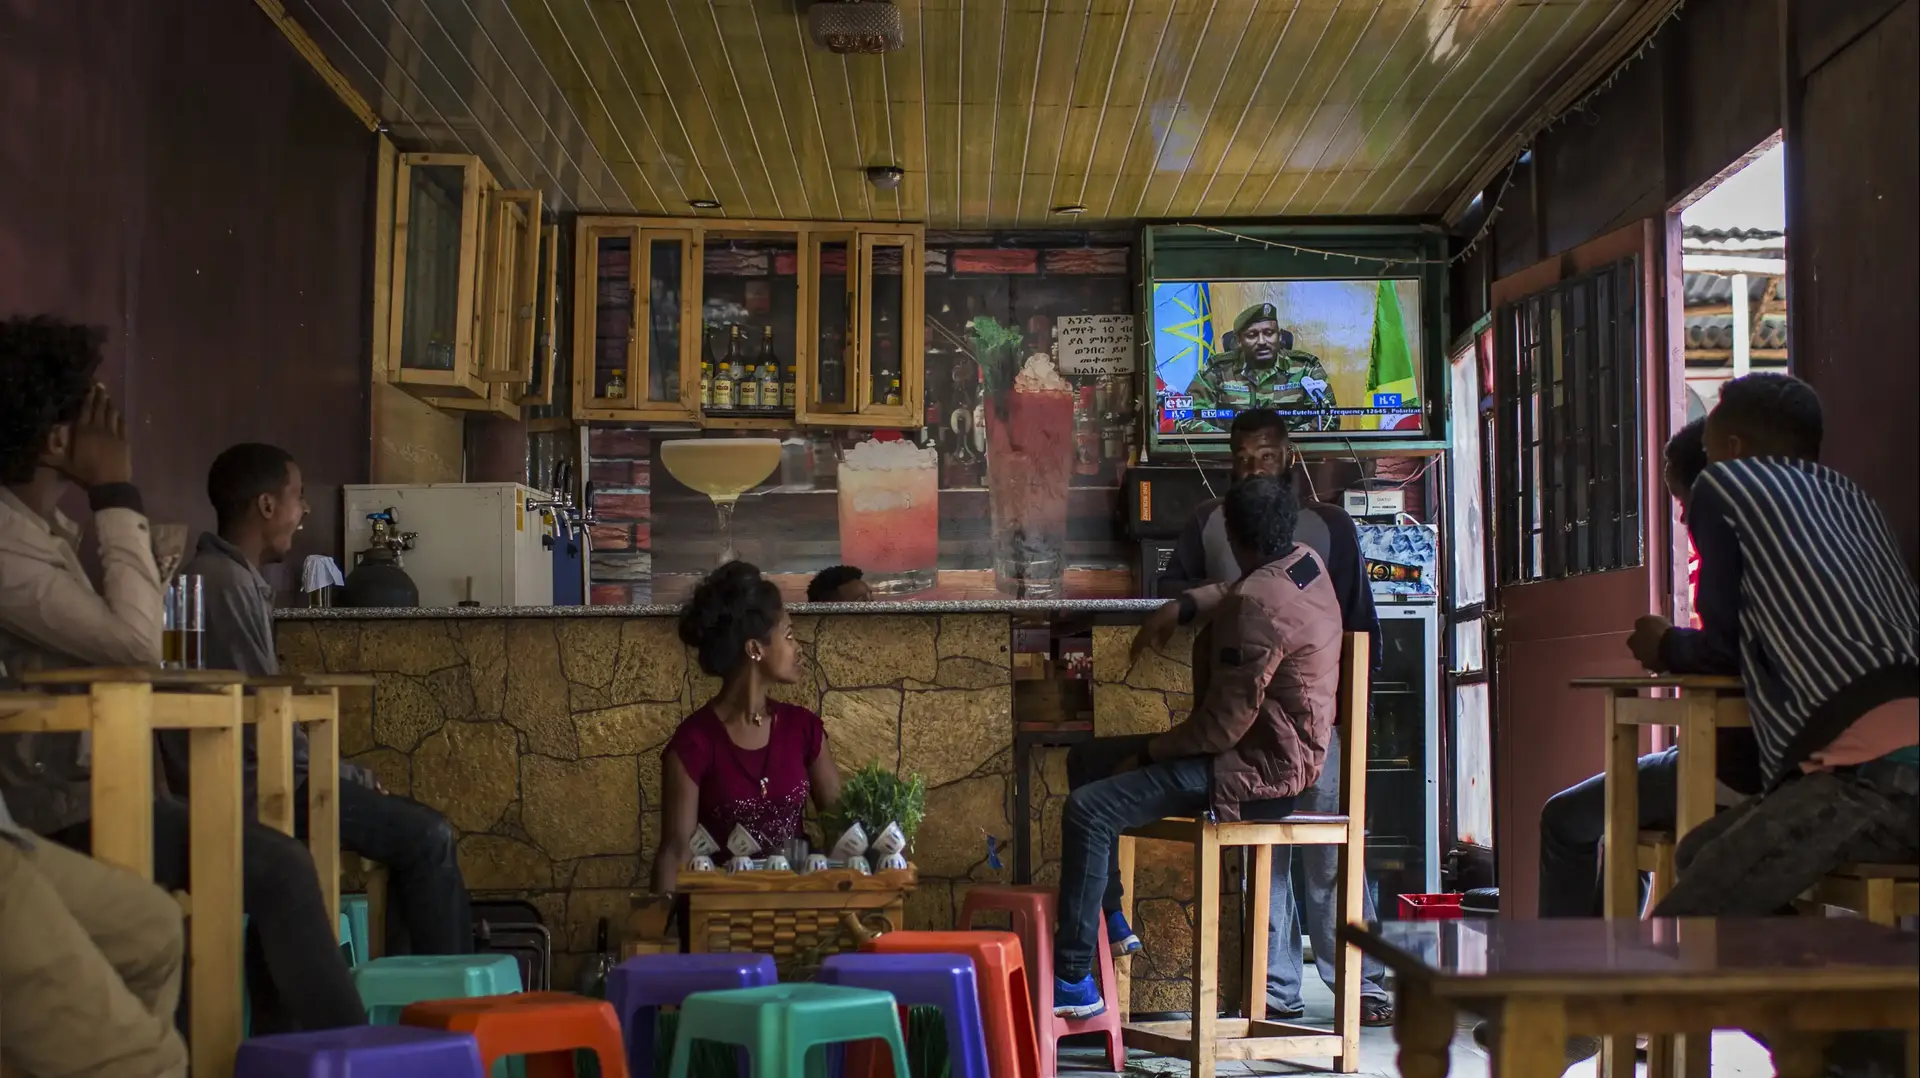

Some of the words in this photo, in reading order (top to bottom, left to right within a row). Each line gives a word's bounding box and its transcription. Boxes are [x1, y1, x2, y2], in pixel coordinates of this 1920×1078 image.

[1062, 326, 1096, 335] ለማየት
[1089, 335, 1132, 344] ምክንያት
[1074, 346, 1105, 355] ወንበር
[1165, 397, 1192, 408] etv
[1379, 395, 1397, 405] ዜና
